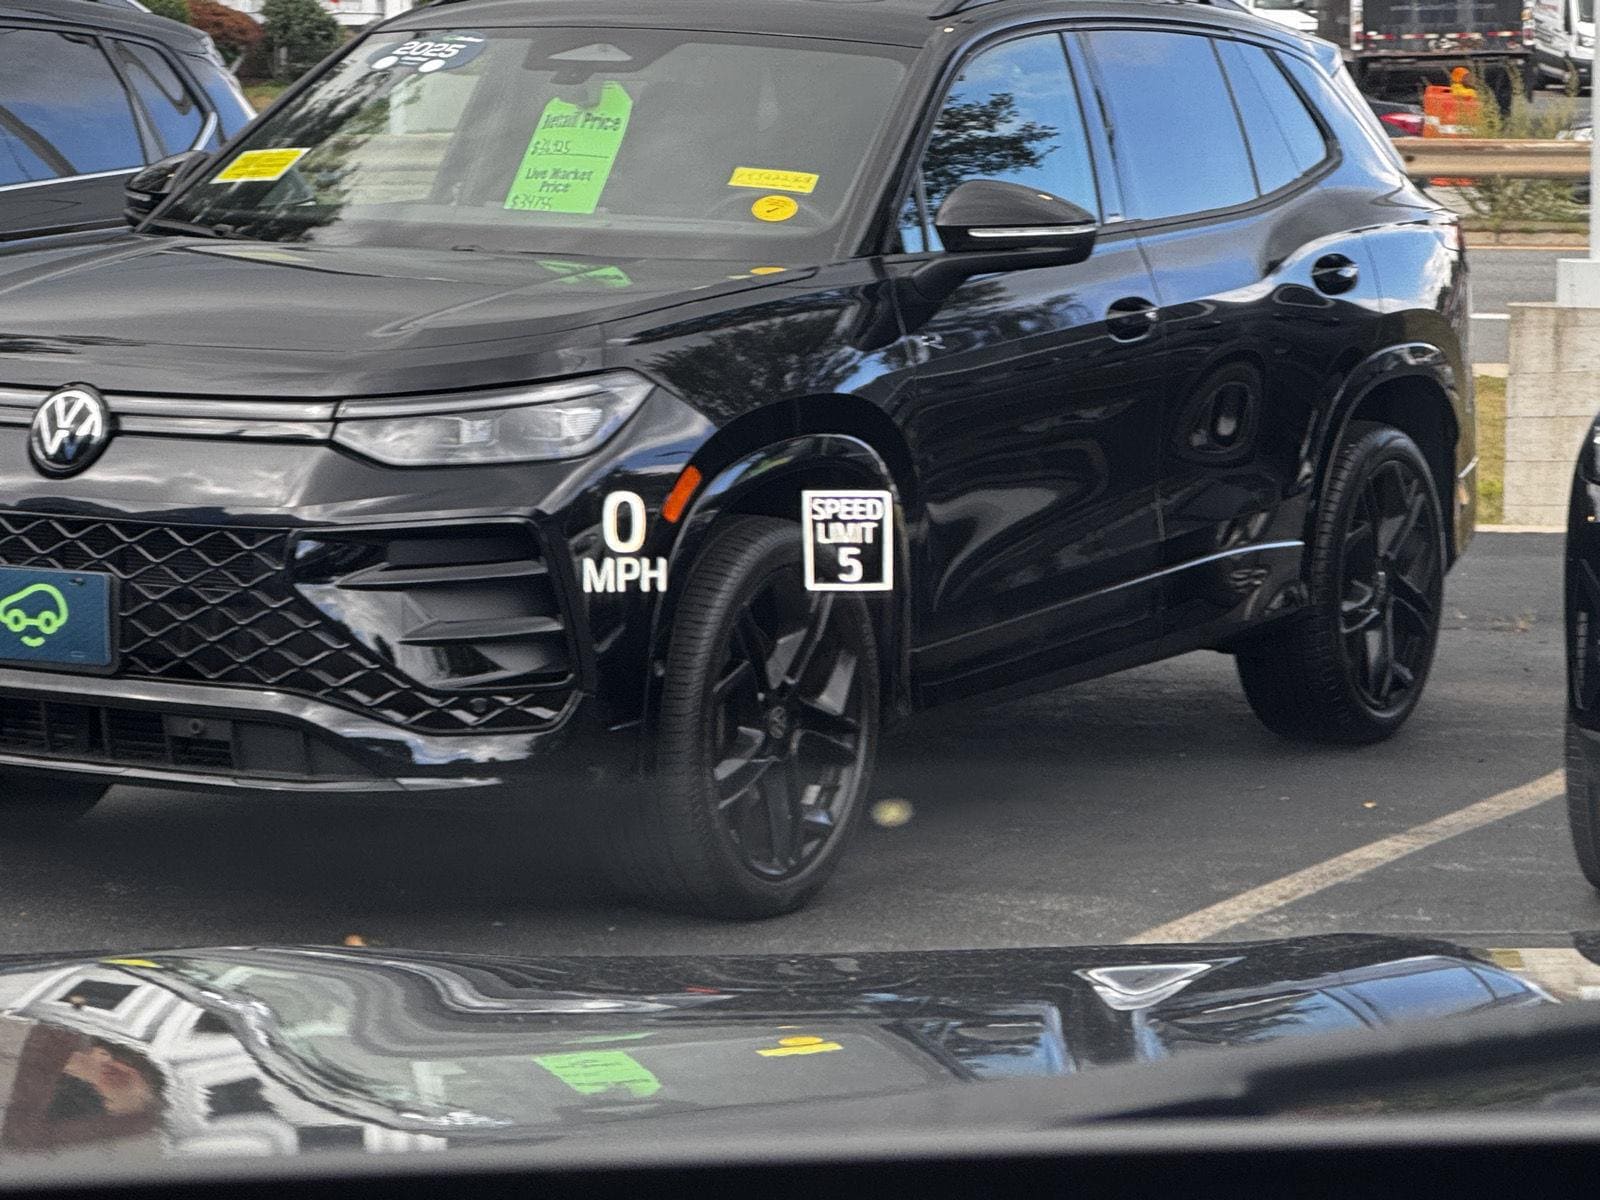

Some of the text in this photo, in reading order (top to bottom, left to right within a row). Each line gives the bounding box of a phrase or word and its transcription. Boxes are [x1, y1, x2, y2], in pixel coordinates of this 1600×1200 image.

[392, 41, 467, 58] 2025
[582, 112, 621, 131] Price
[526, 168, 594, 181] Live Market
[540, 181, 571, 193] Price
[811, 498, 884, 521] SPEED
[603, 490, 647, 553] 0
[815, 522, 879, 544] LIMIT
[582, 557, 668, 593] MPH
[838, 547, 864, 582] 5
